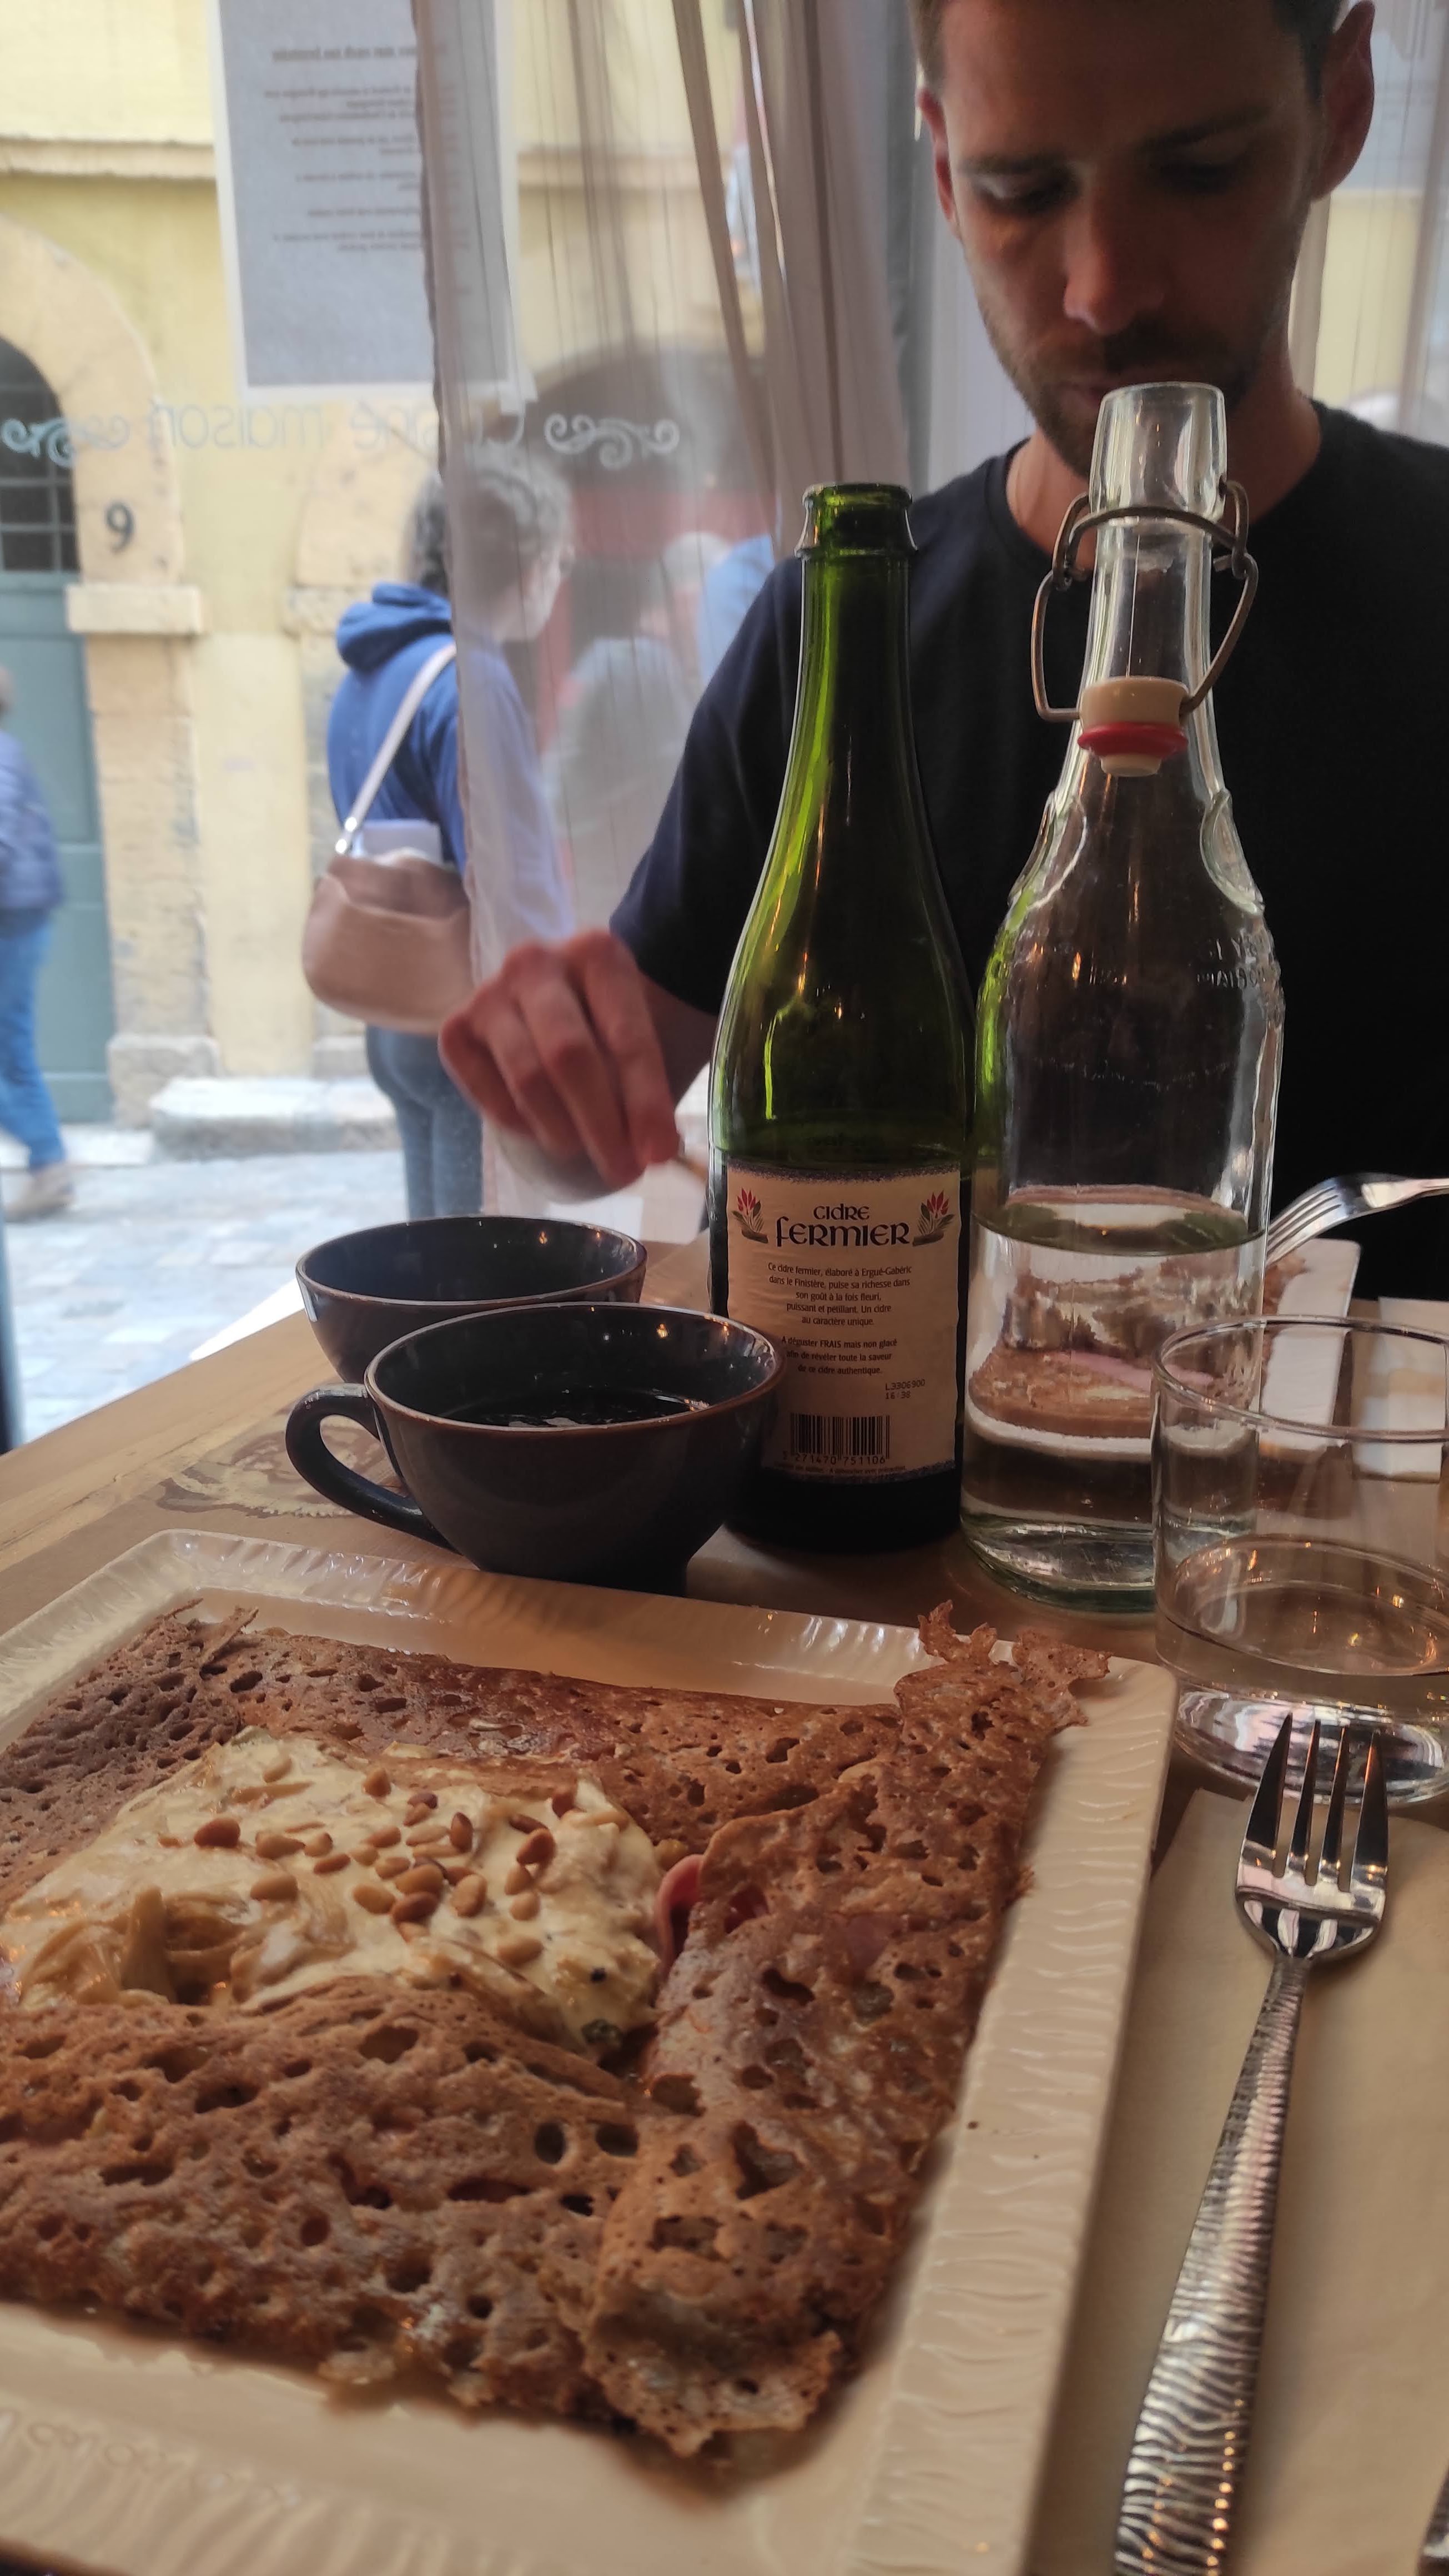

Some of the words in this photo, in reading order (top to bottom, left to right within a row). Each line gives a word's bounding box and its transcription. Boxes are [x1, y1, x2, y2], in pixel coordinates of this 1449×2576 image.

[105, 501, 134, 554] 9
[768, 1262, 776, 1271] Ce
[778, 1264, 794, 1273] cidre
[796, 1266, 823, 1276] fermier,
[825, 1267, 853, 1276] élaboré
[862, 1265, 912, 1279] Ergué-Gabéric
[769, 1276, 784, 1285] dans
[787, 1277, 792, 1286] le
[828, 1281, 849, 1290] puise
[862, 1279, 891, 1289] richesse
[893, 1279, 910, 1287] dans
[811, 1292, 827, 1302] goût
[836, 1292, 843, 1301] la
[845, 1292, 858, 1301] fois
[787, 1302, 816, 1312] puissant
[818, 1304, 824, 1312] et
[861, 1305, 872, 1314] Un
[874, 1304, 892, 1313] cidre
[813, 1316, 845, 1326] caractère
[788, 1336, 818, 1347] déguster
[820, 1340, 841, 1348] FRAIS
[844, 1340, 861, 1349] mais
[879, 1339, 897, 1350] glacé
[786, 1350, 799, 1359] afin
[801, 1350, 809, 1359] de
[812, 1351, 837, 1361] révéler
[838, 1353, 858, 1361] toute
[859, 1353, 866, 1361] la
[818, 1366, 835, 1374] cidre
